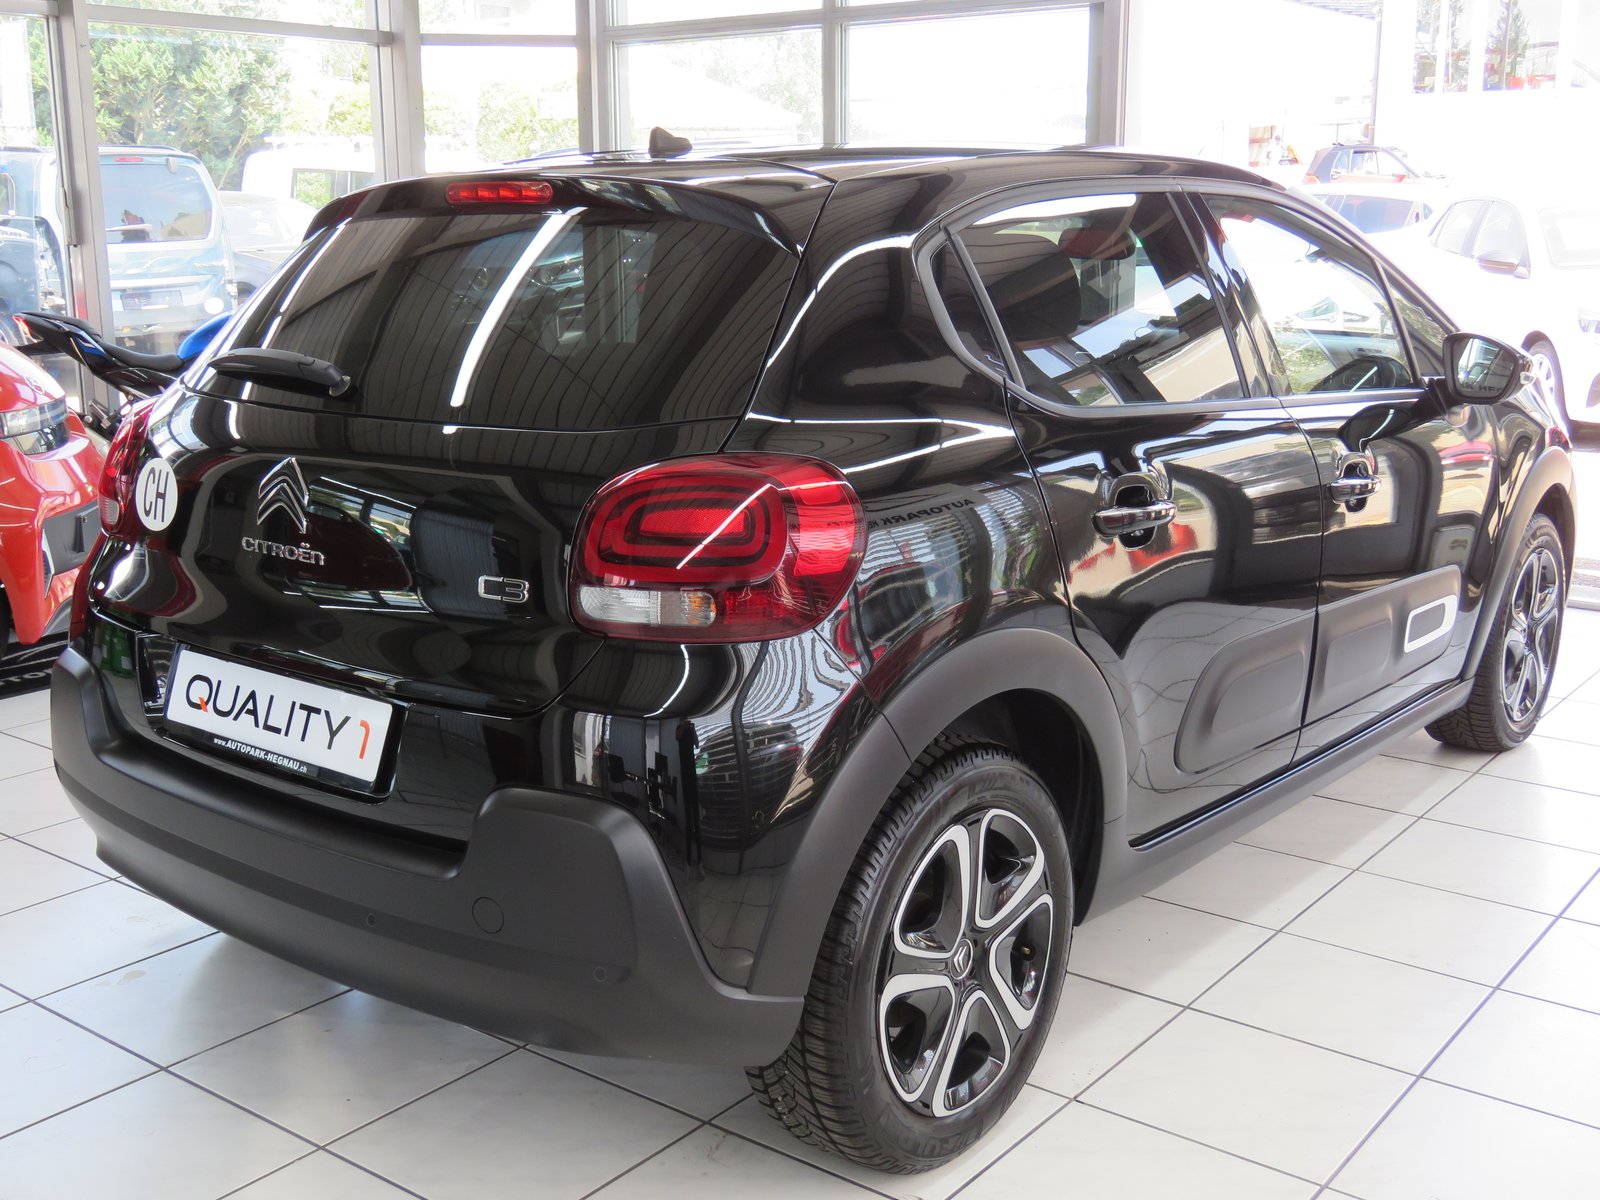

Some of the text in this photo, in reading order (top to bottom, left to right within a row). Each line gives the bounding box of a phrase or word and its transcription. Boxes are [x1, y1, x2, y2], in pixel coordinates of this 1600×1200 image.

[143, 466, 169, 523] CH
[477, 575, 530, 603] C3
[185, 673, 352, 750] QUALITY
[213, 737, 308, 773] www.AUTOPARK-HEGNAU.ch
